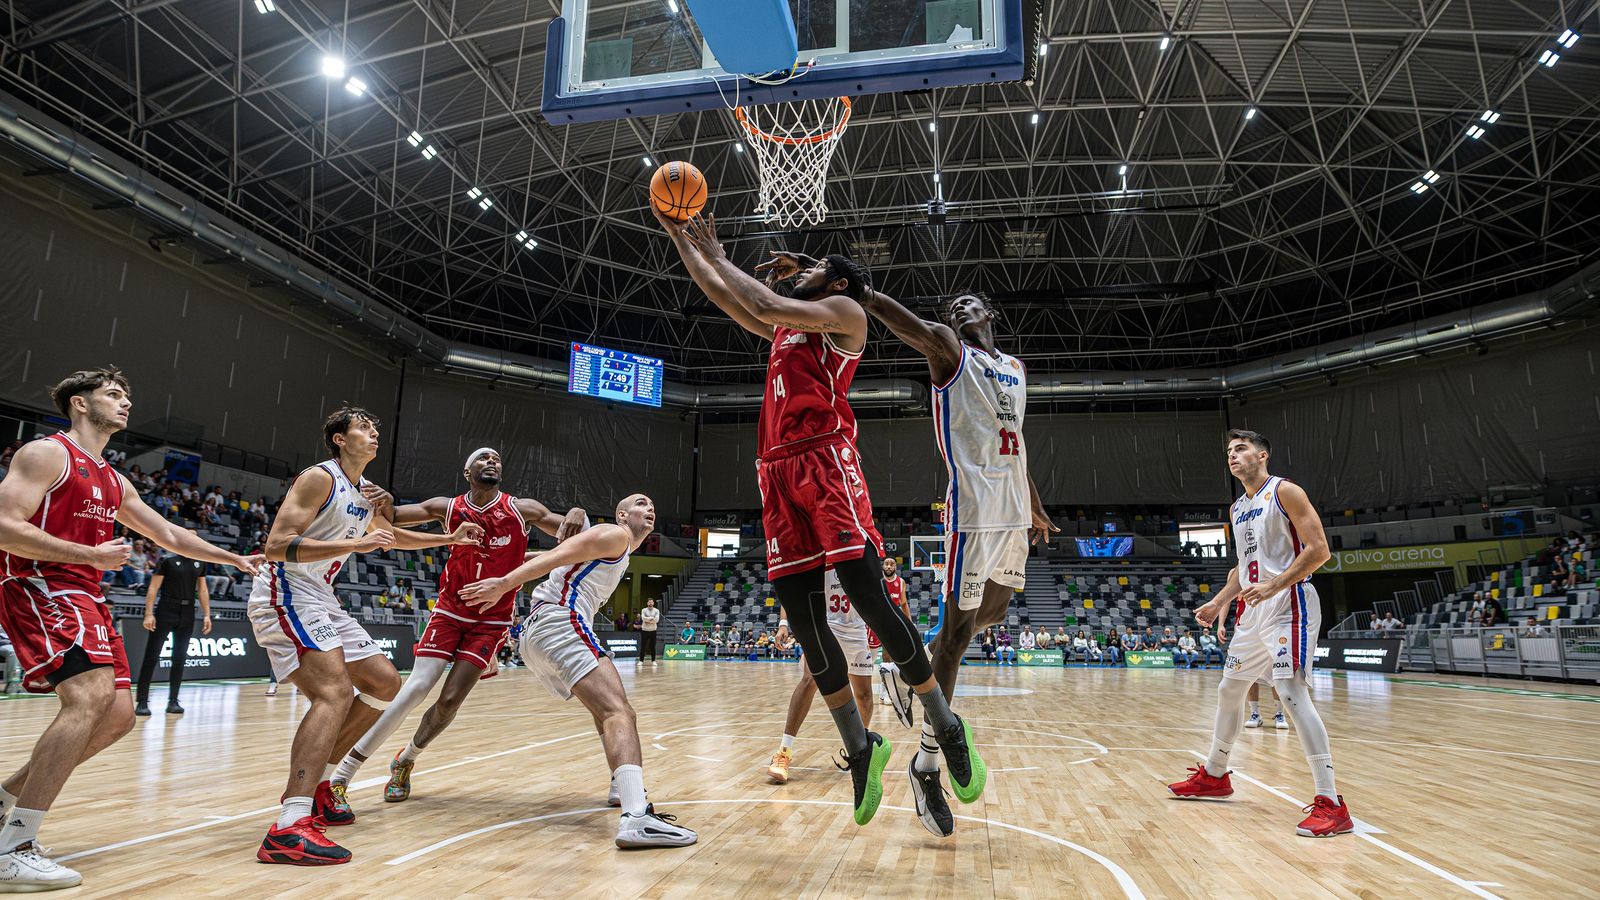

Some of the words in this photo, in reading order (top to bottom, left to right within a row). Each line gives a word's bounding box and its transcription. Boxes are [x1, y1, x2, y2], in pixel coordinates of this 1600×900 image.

[609, 372, 627, 383] 7:49
[772, 373, 786, 402] 14
[704, 517, 726, 525] Salida
[726, 514, 737, 524] 12
[886, 543, 897, 552] 30
[1344, 550, 1384, 564] olivo
[1389, 547, 1444, 561] arena
[476, 562, 482, 579] 1
[1248, 560, 1259, 583] 8
[829, 595, 850, 613] 33
[94, 624, 109, 642] 10
[429, 629, 437, 641] 1
